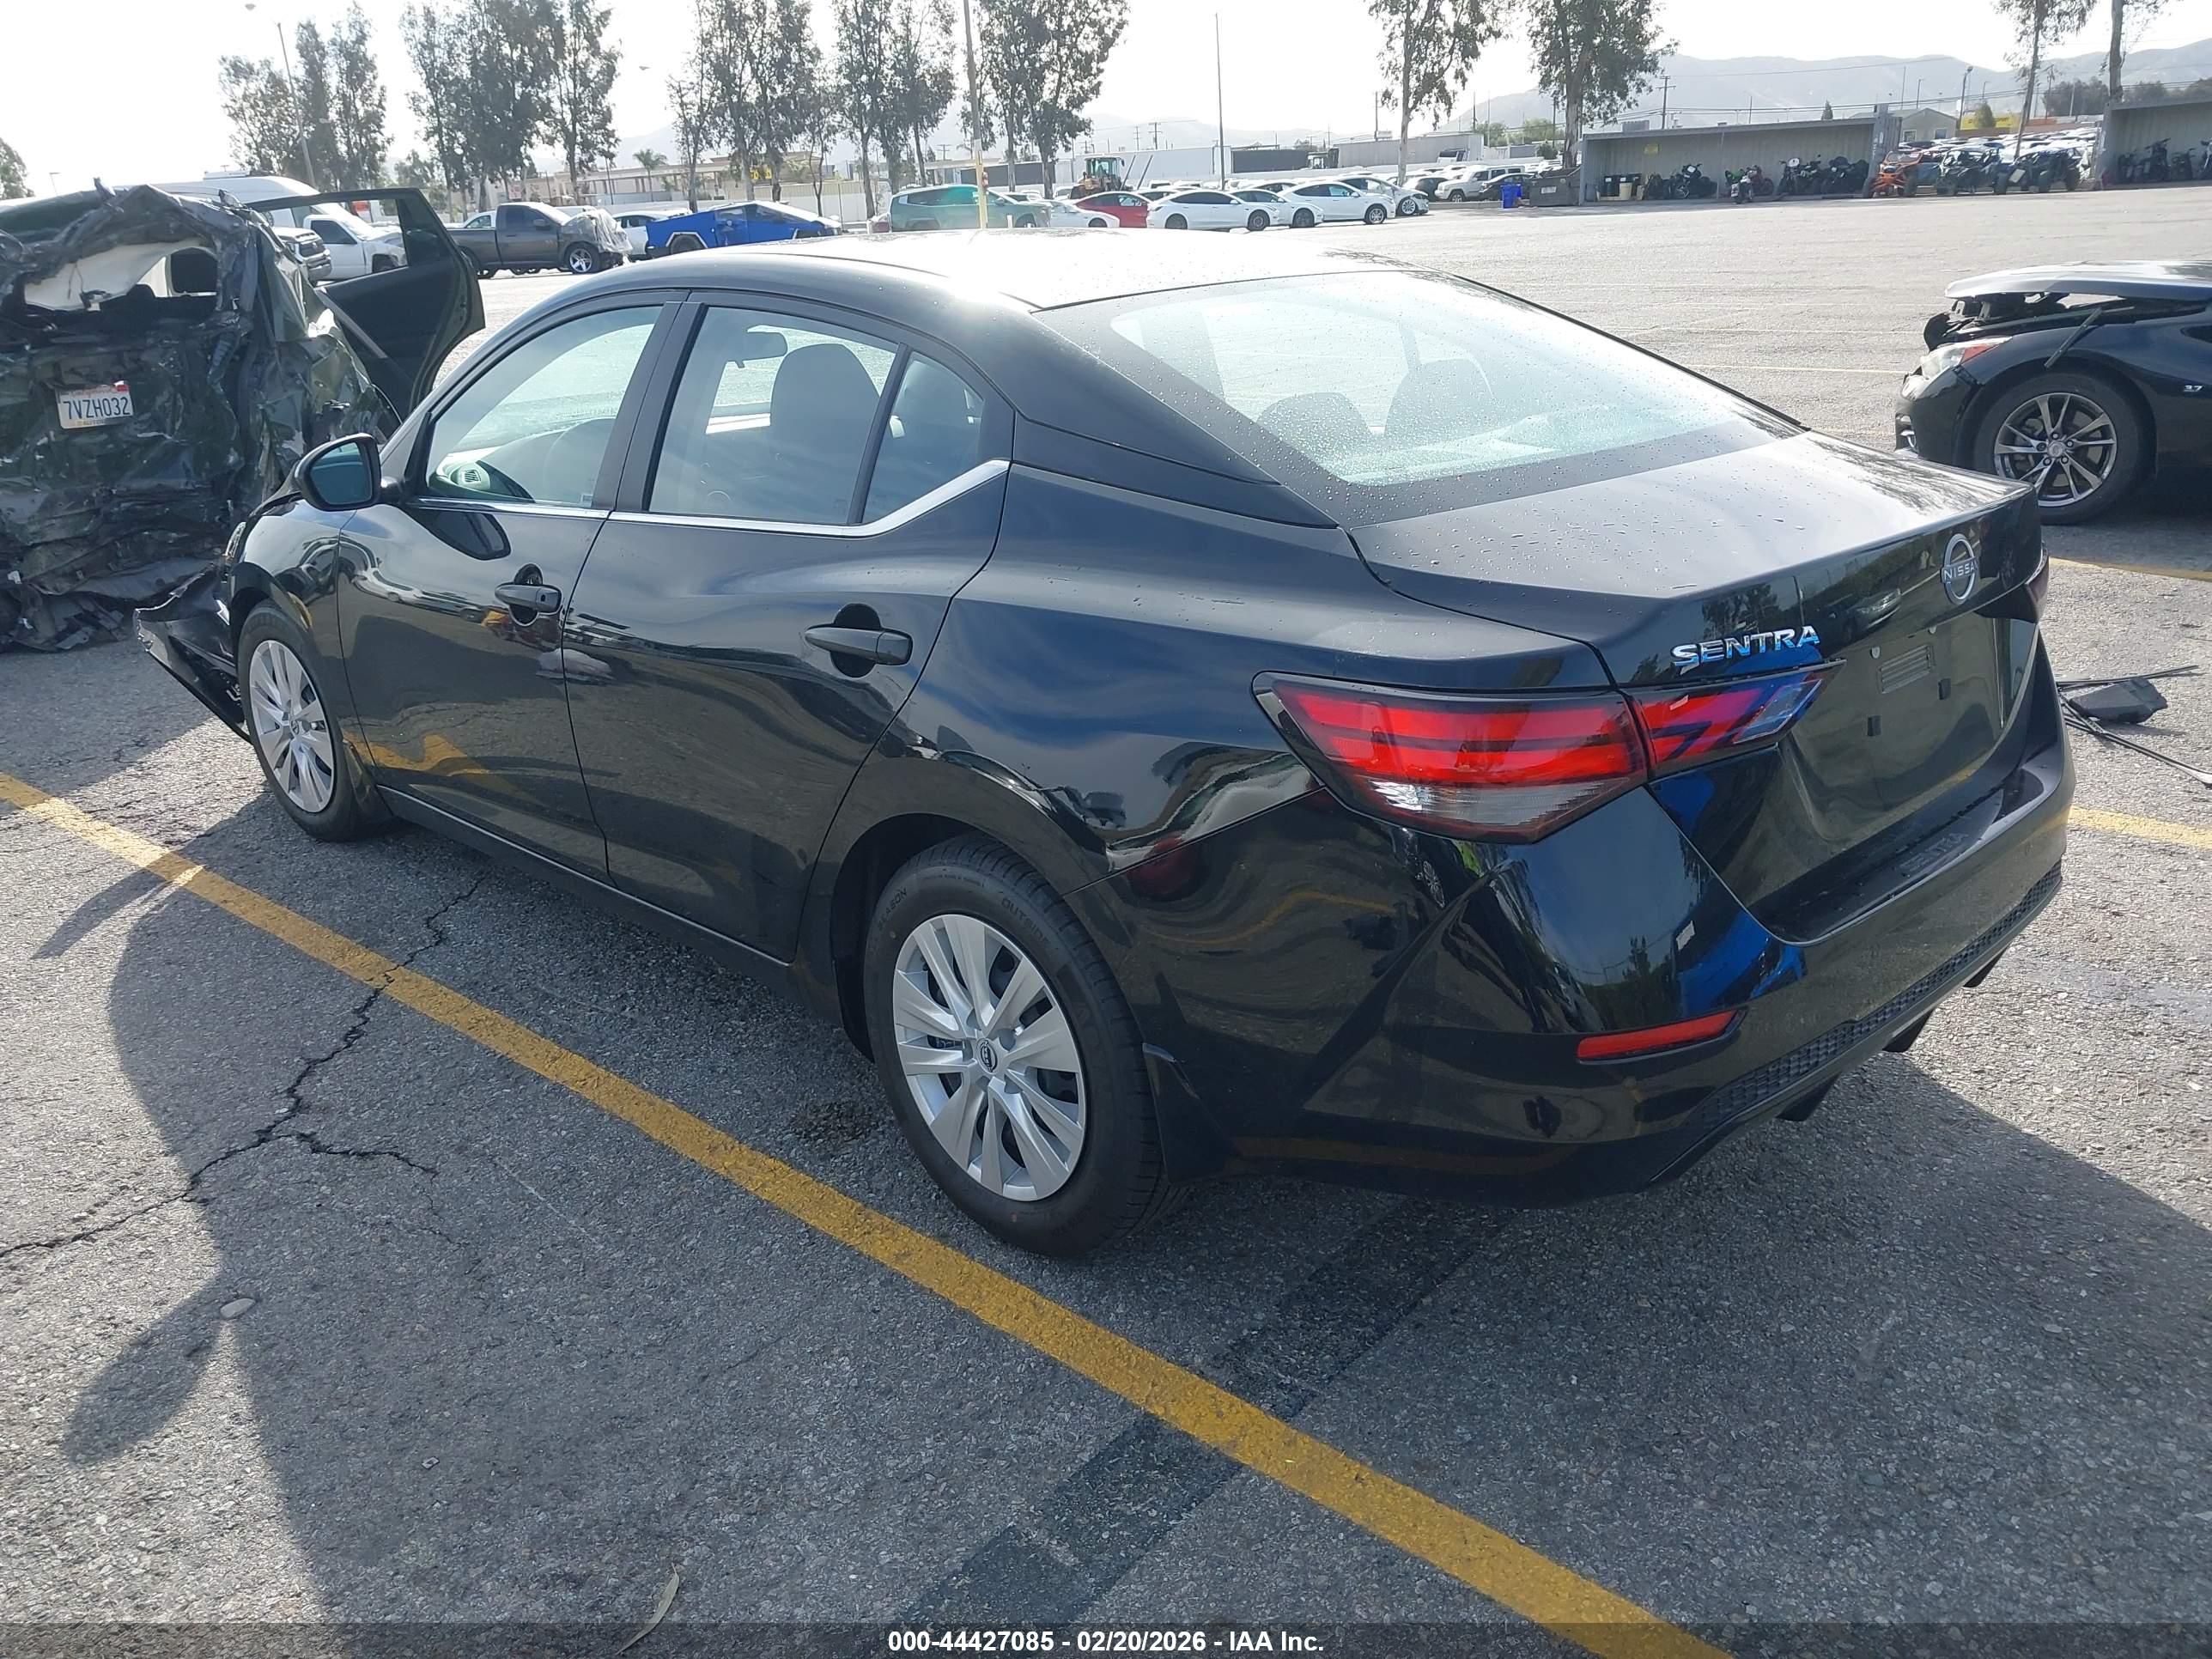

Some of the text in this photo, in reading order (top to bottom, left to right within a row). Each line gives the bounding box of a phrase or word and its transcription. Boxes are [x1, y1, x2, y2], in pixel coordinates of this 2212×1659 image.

[63, 397, 131, 420] 7VZH032
[1943, 559, 1978, 581] NISSA
[1672, 625, 1820, 676] SENTRA
